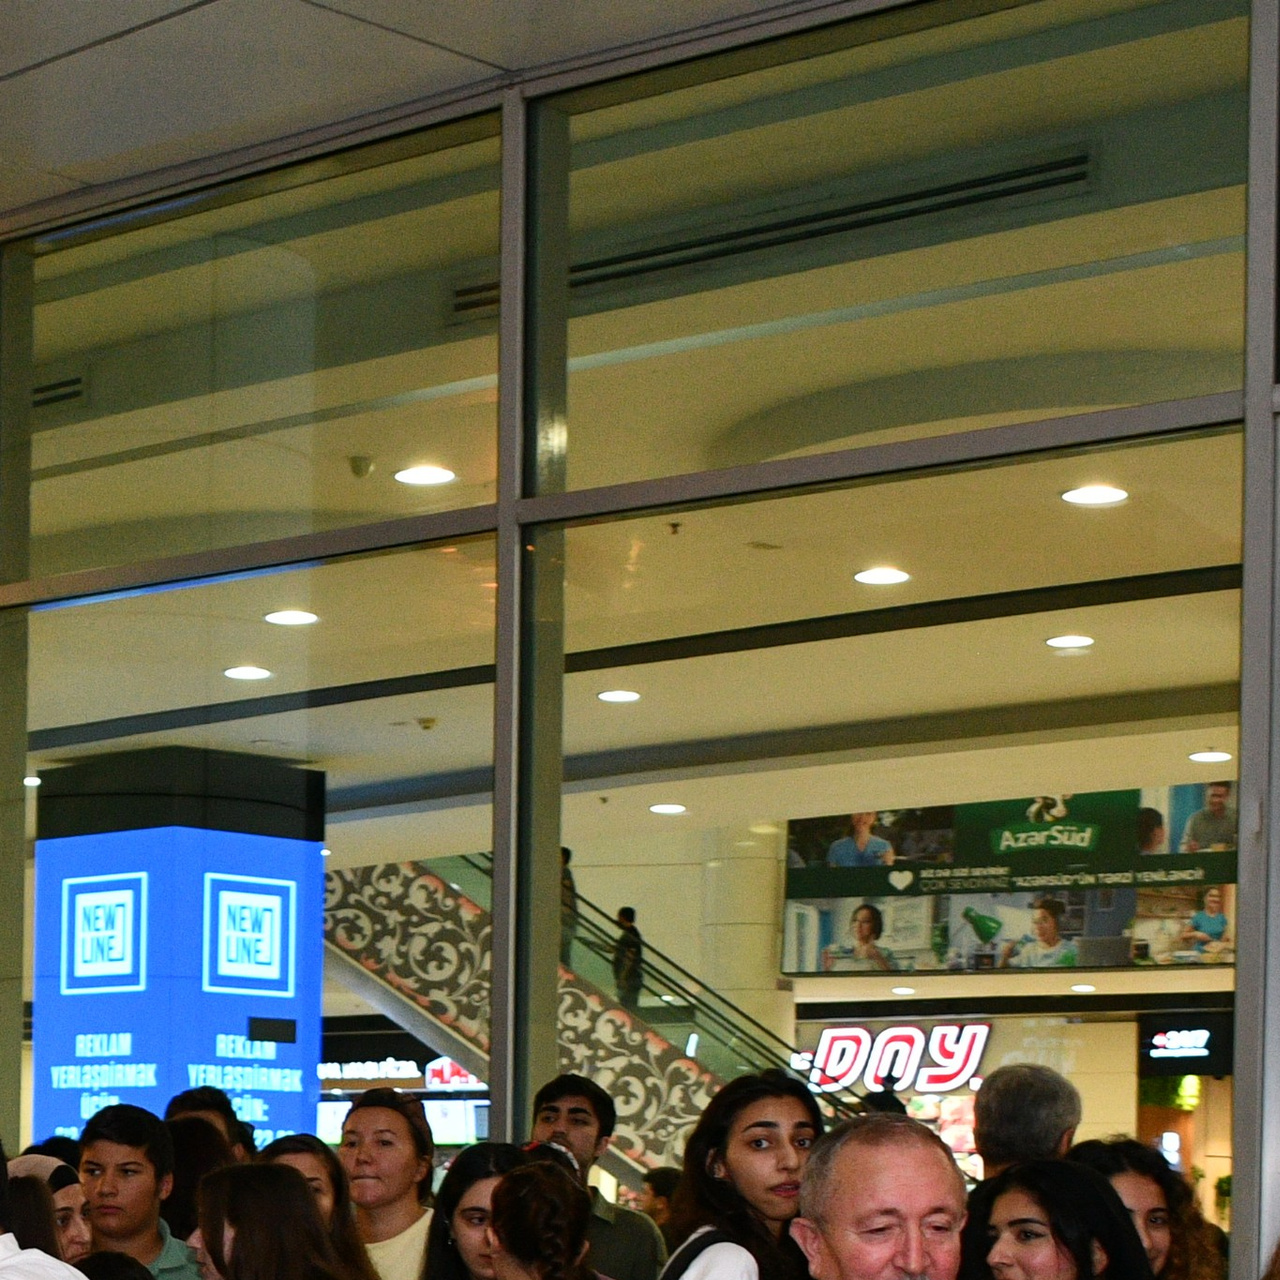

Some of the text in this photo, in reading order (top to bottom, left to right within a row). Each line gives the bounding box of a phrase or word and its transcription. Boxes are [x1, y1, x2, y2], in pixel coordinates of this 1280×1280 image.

[1000, 825, 1093, 851] AzarSüd
[82, 904, 118, 932] NEW
[227, 905, 265, 933] NEW
[82, 935, 123, 963] LINE
[227, 936, 271, 965] LINE
[75, 1032, 131, 1057] REKLAM
